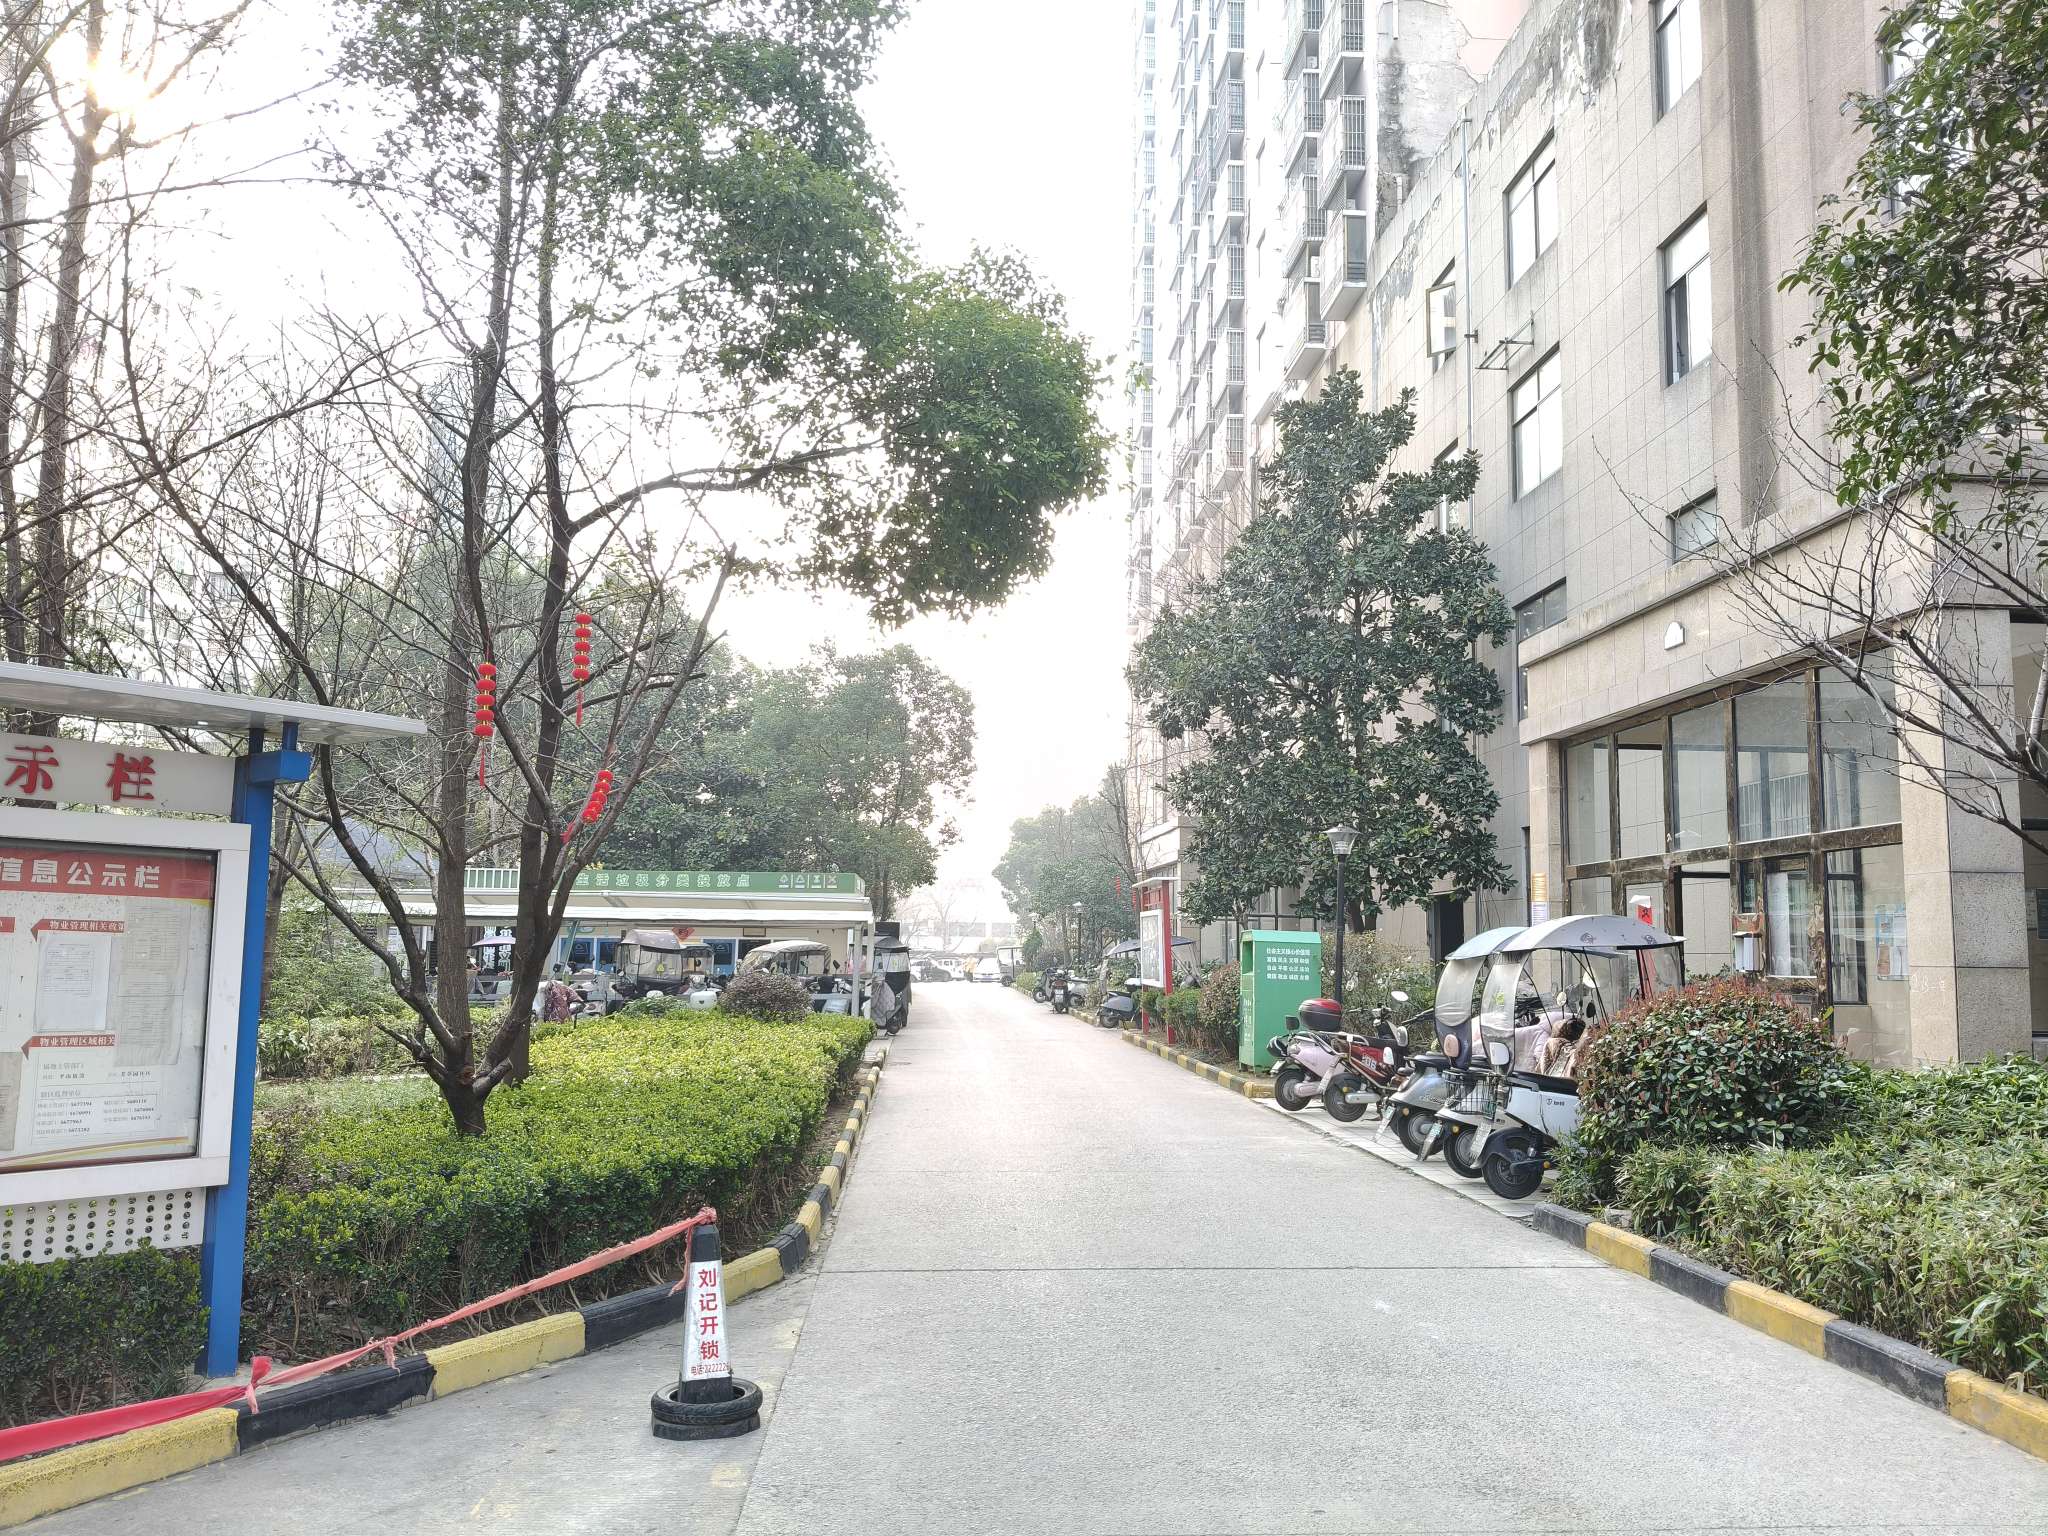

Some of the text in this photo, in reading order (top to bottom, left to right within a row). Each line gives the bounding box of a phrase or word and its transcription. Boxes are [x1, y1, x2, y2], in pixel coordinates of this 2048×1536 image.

[0, 857, 160, 889] 信息公示栏
[698, 1267, 720, 1360] 刘记开锁
